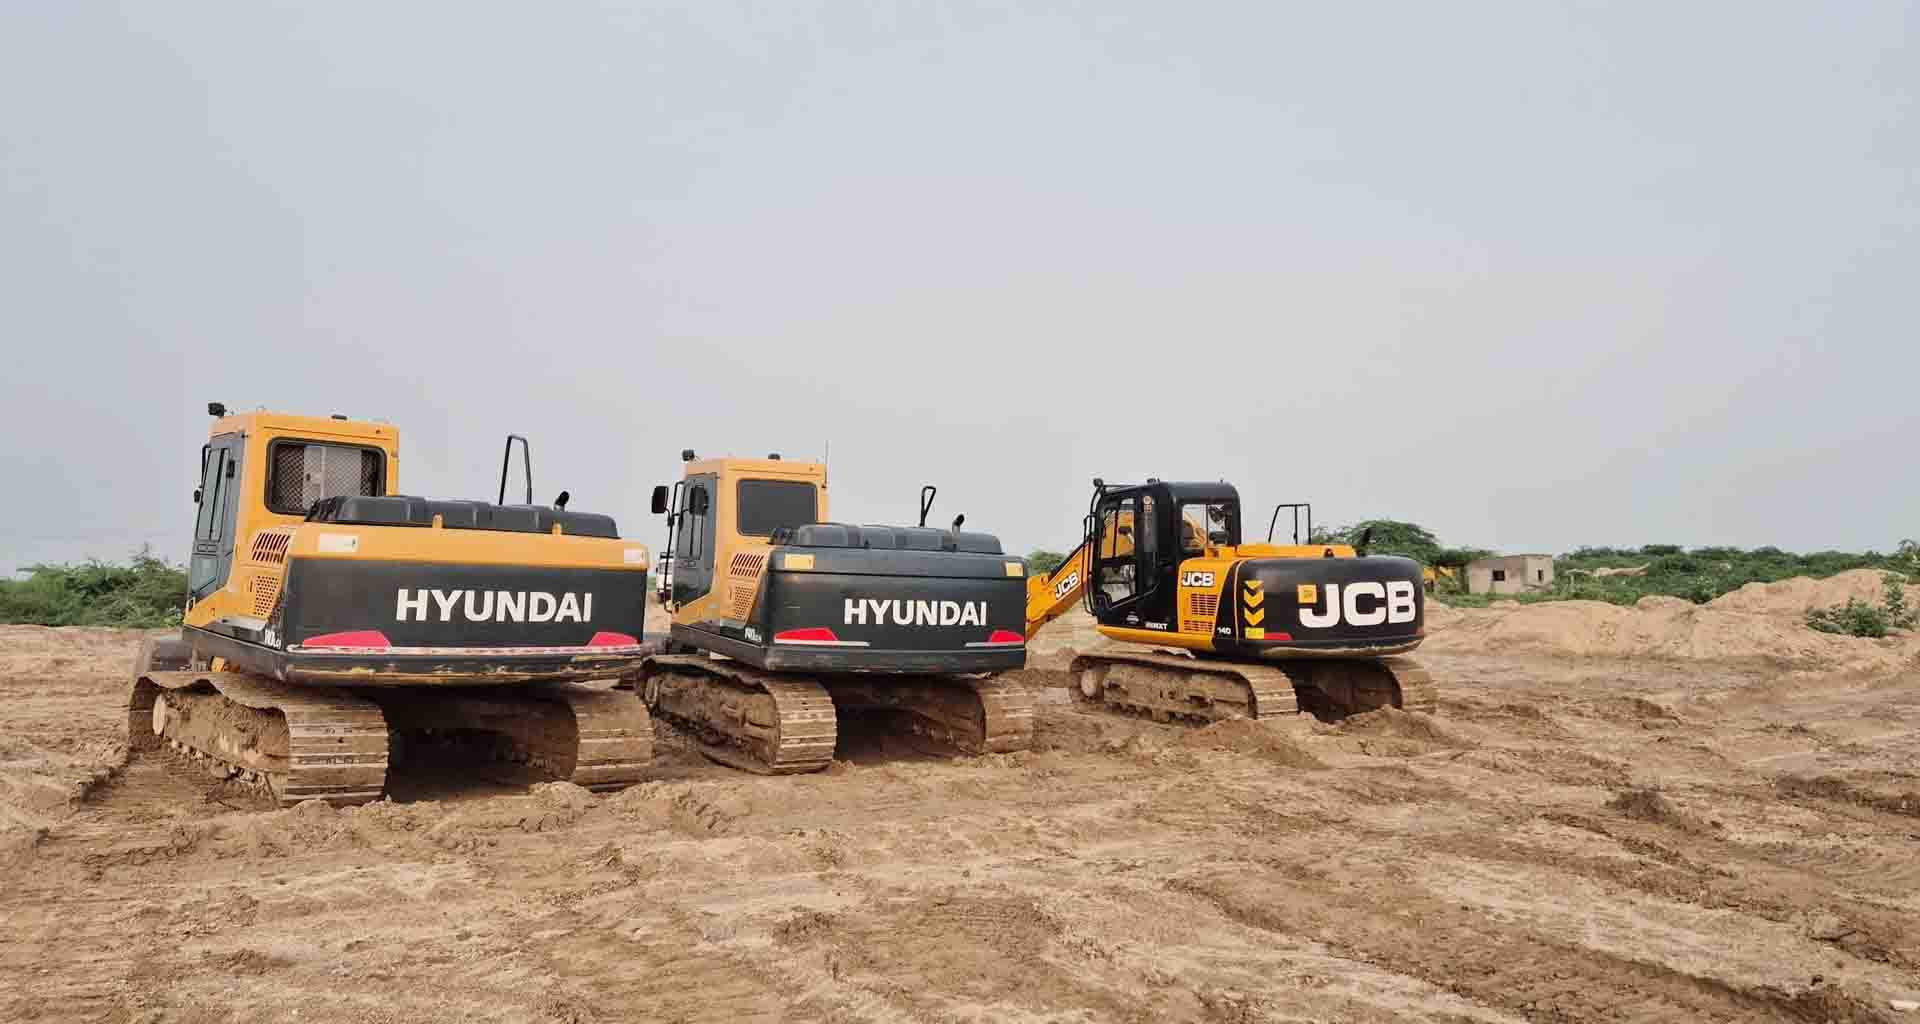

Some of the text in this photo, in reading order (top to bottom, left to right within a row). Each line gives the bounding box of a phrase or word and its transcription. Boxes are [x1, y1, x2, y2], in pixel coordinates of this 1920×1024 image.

[1055, 571, 1080, 598] JCB
[1182, 571, 1215, 587] JCB
[396, 588, 593, 623] HYUNDAI
[843, 598, 988, 626] HYUNDAI
[1298, 580, 1416, 628] JCB
